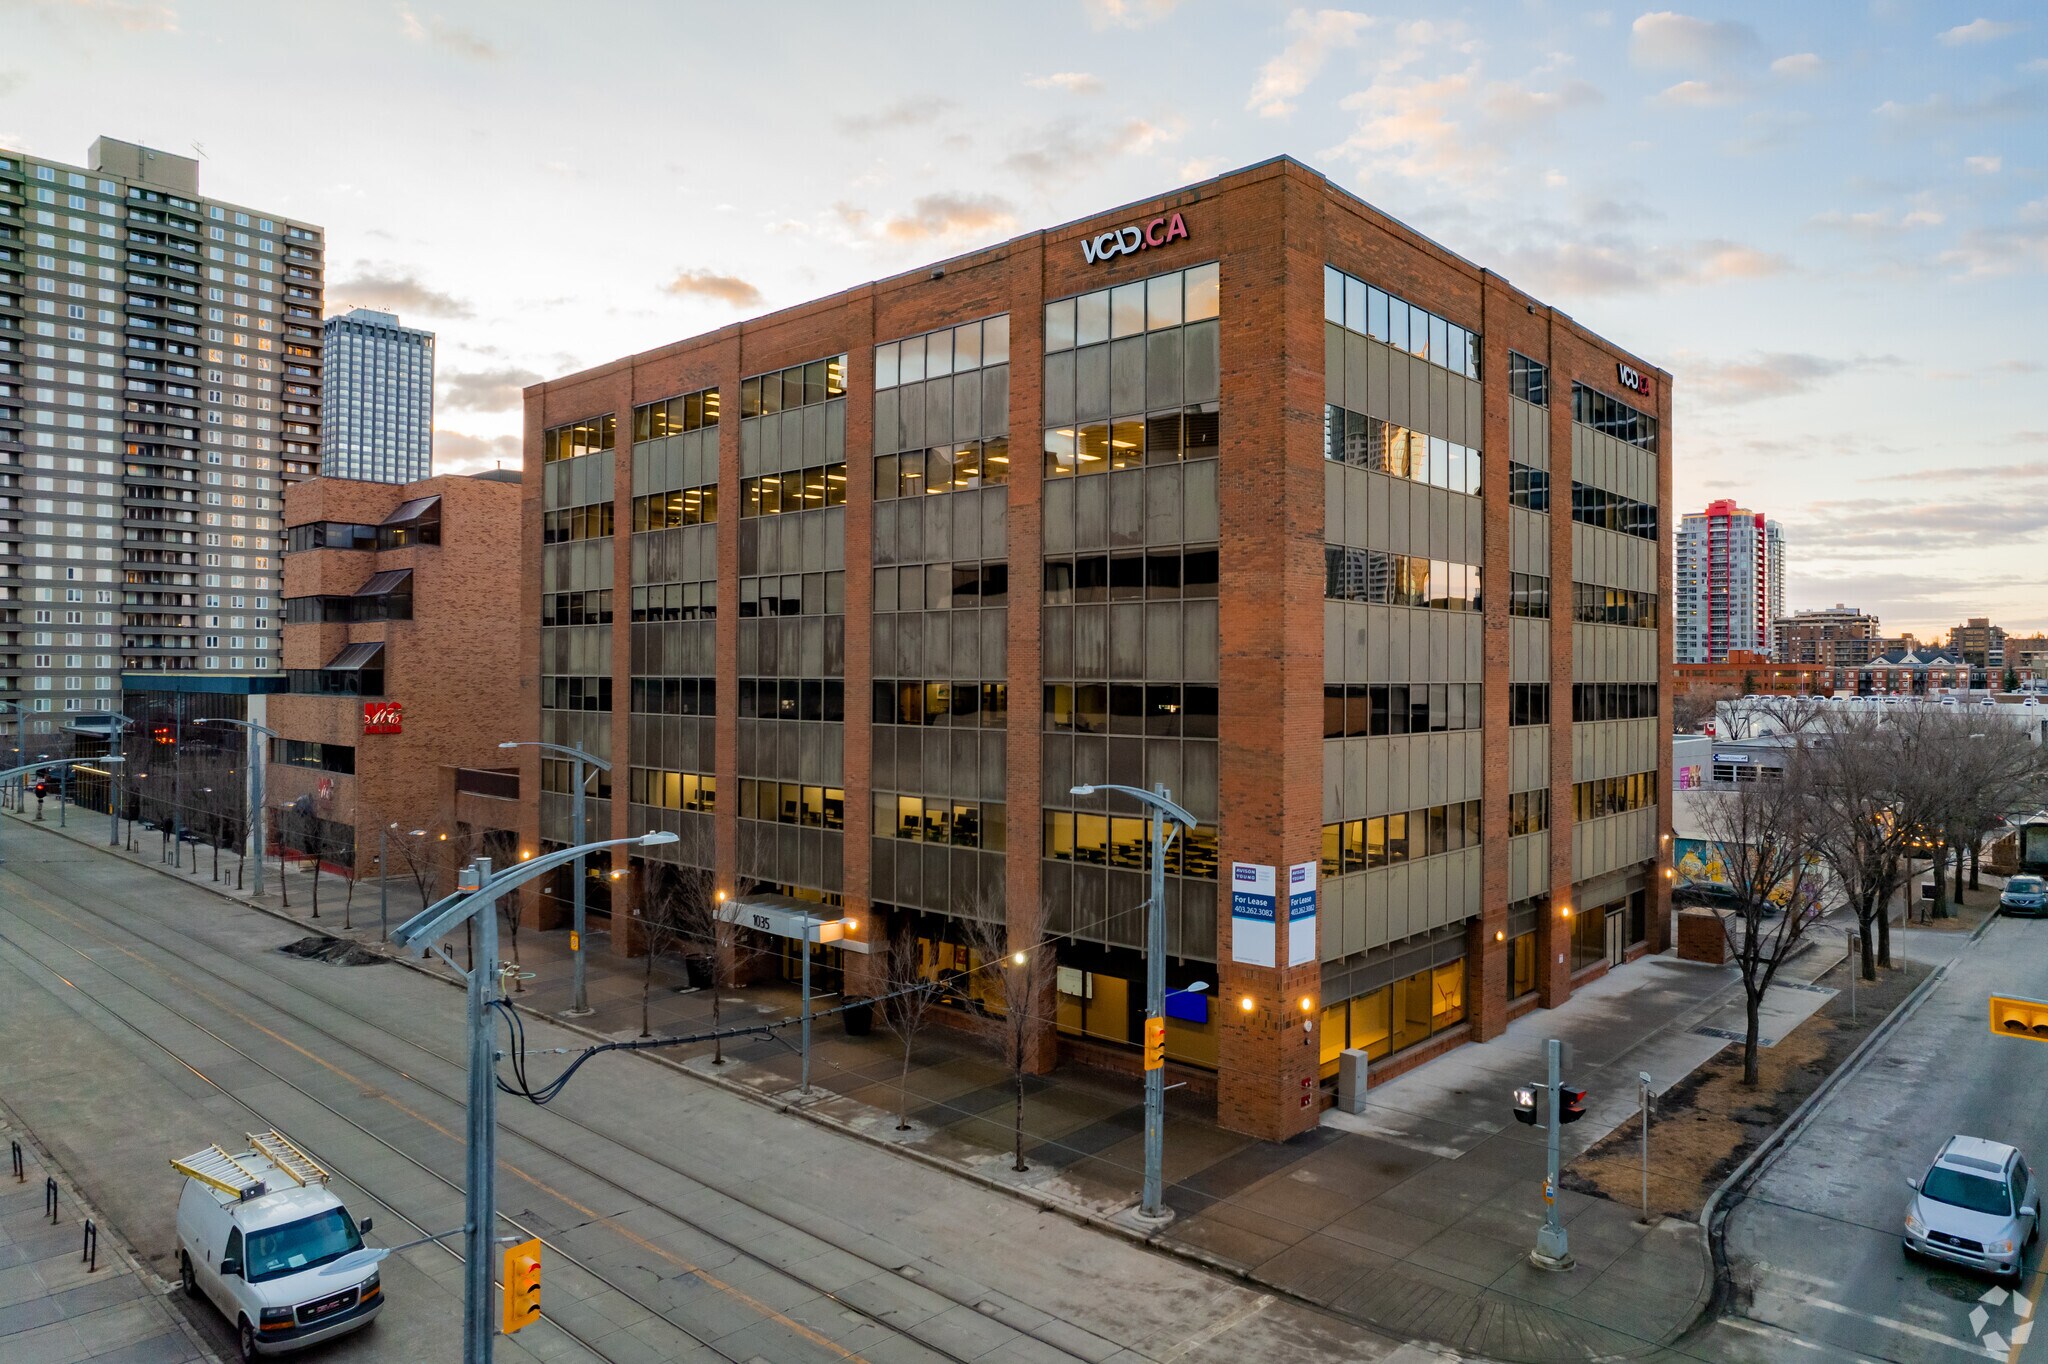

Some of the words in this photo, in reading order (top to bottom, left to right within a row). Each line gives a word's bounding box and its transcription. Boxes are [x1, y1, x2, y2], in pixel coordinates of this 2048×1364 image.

[1235, 895, 1246, 903] For
[1248, 897, 1268, 906] Lease
[1299, 896, 1312, 904] Lease
[1235, 906, 1273, 917] 403.262.3082
[753, 914, 770, 930] 1035
